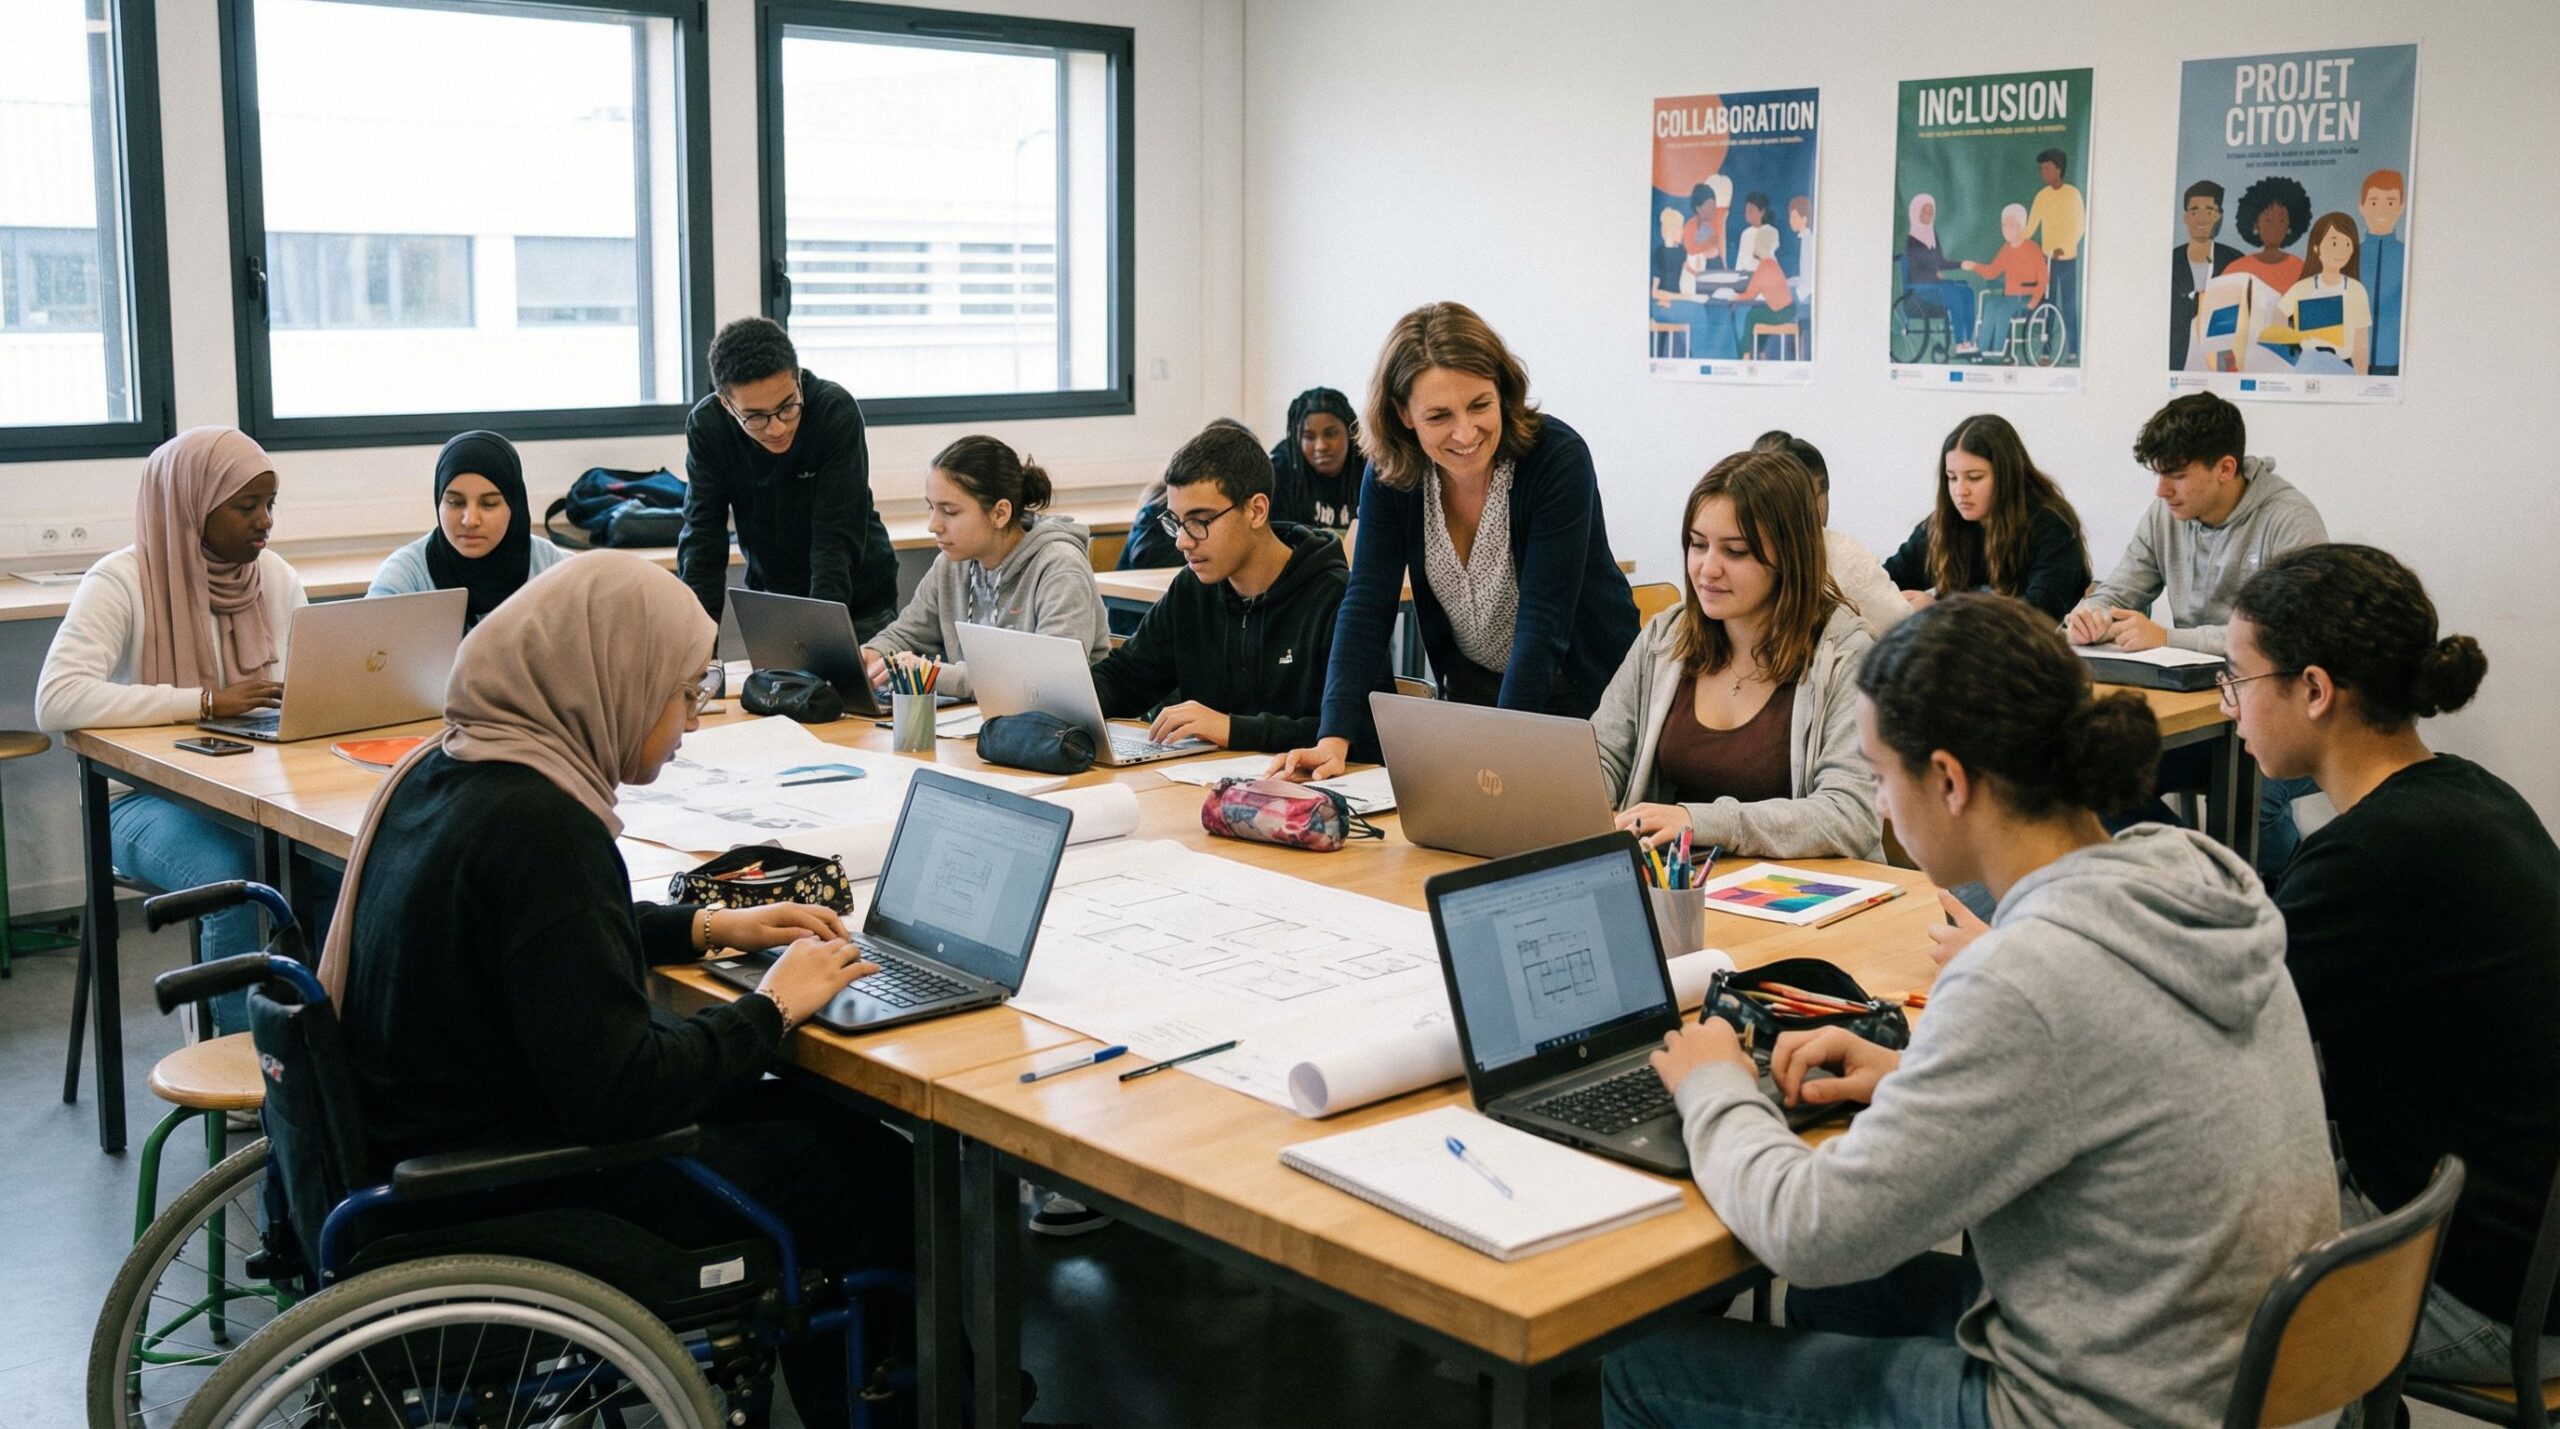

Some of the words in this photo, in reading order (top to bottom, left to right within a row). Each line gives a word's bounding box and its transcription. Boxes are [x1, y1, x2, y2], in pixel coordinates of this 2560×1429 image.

[1918, 80, 2068, 127] INCLUSION
[2235, 58, 2355, 104] PROJET
[1656, 101, 1815, 138] COLLABORATION
[2225, 101, 2361, 147] CITOYEN
[1476, 767, 1504, 796] hp
